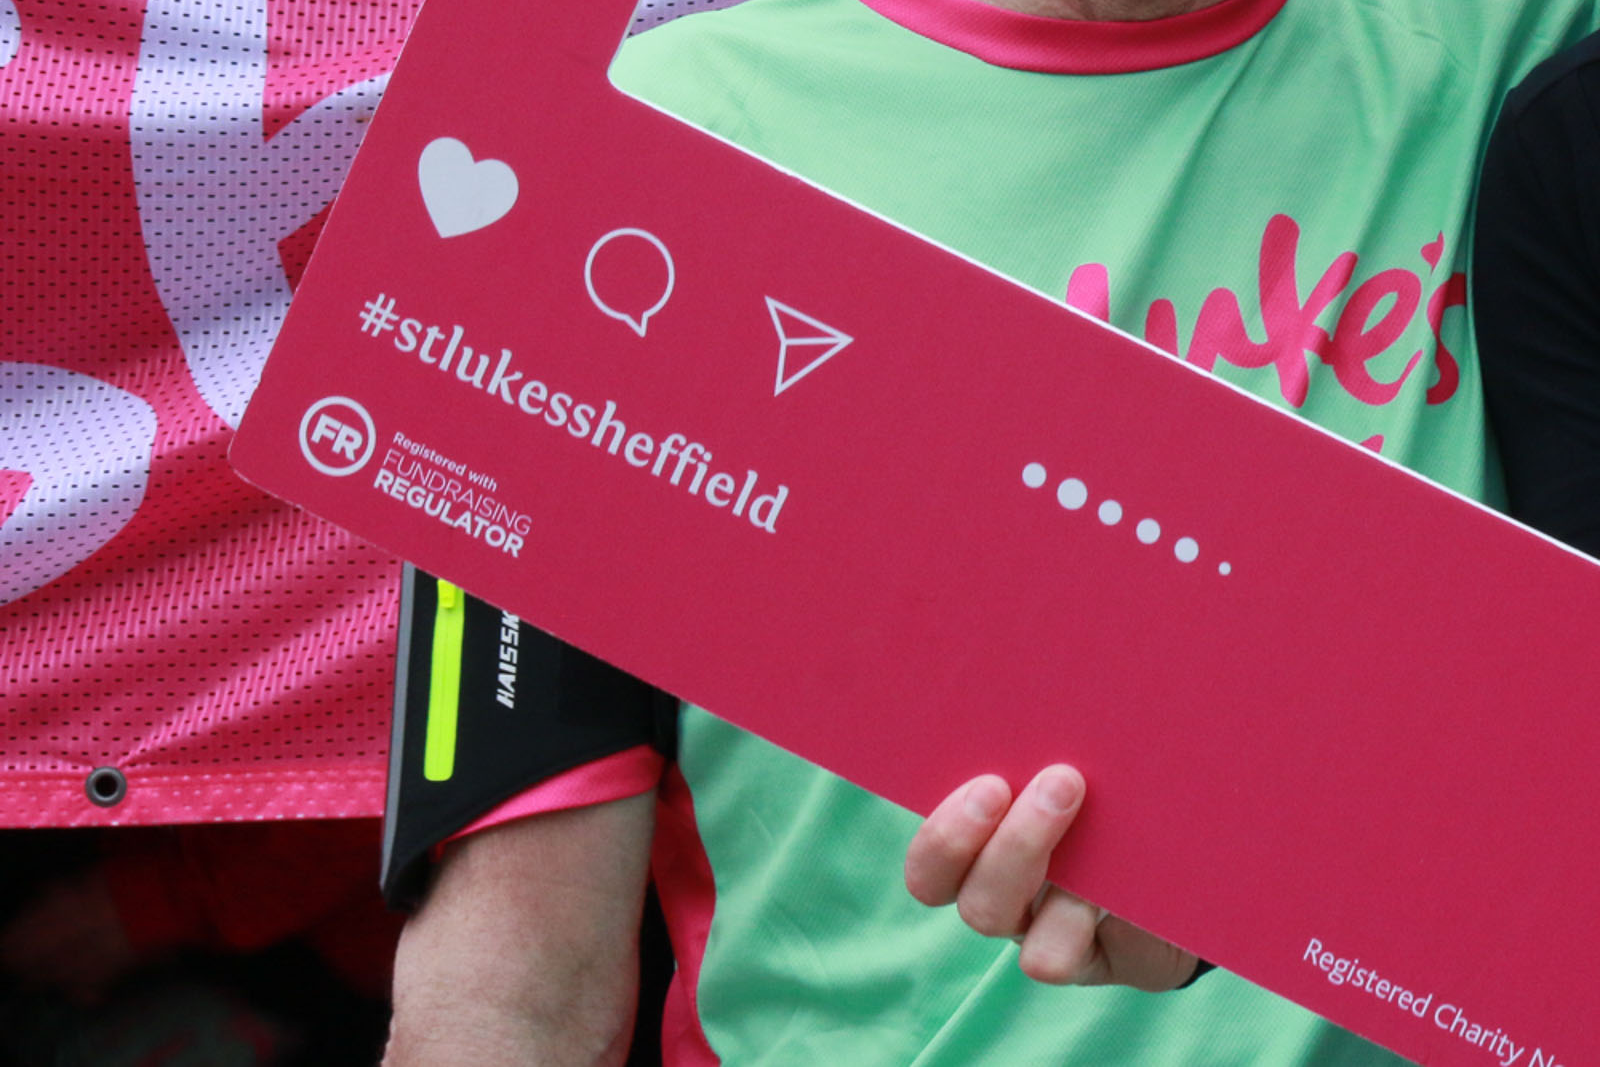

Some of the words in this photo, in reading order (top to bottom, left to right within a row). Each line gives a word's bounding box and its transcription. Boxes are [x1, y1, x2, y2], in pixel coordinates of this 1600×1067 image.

[310, 413, 363, 462] FR
[358, 293, 790, 534] #stlukessheffield
[381, 447, 533, 536] FUNDRAISING
[392, 431, 468, 477] Registered
[467, 470, 498, 493] with
[373, 467, 525, 558] REGULATOR
[1303, 937, 1433, 1018] Registered
[1434, 1003, 1525, 1067] Charity
